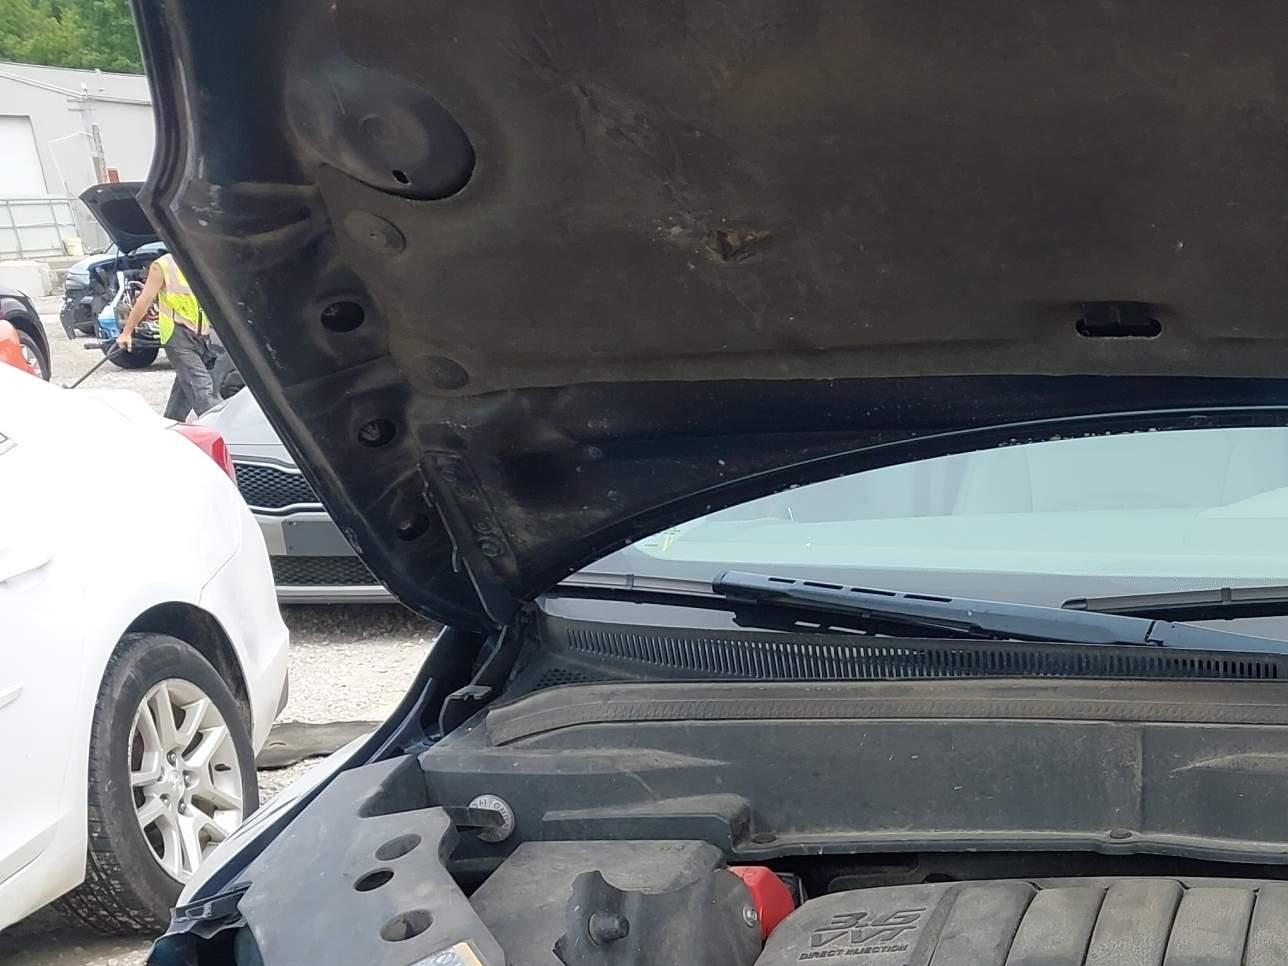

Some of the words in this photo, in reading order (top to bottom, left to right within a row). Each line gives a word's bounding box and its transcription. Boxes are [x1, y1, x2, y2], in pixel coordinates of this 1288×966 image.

[814, 908, 926, 932] 3.6
[810, 926, 917, 947] VVT
[798, 949, 844, 961] DIRECT
[845, 943, 909, 957] INJECTION
